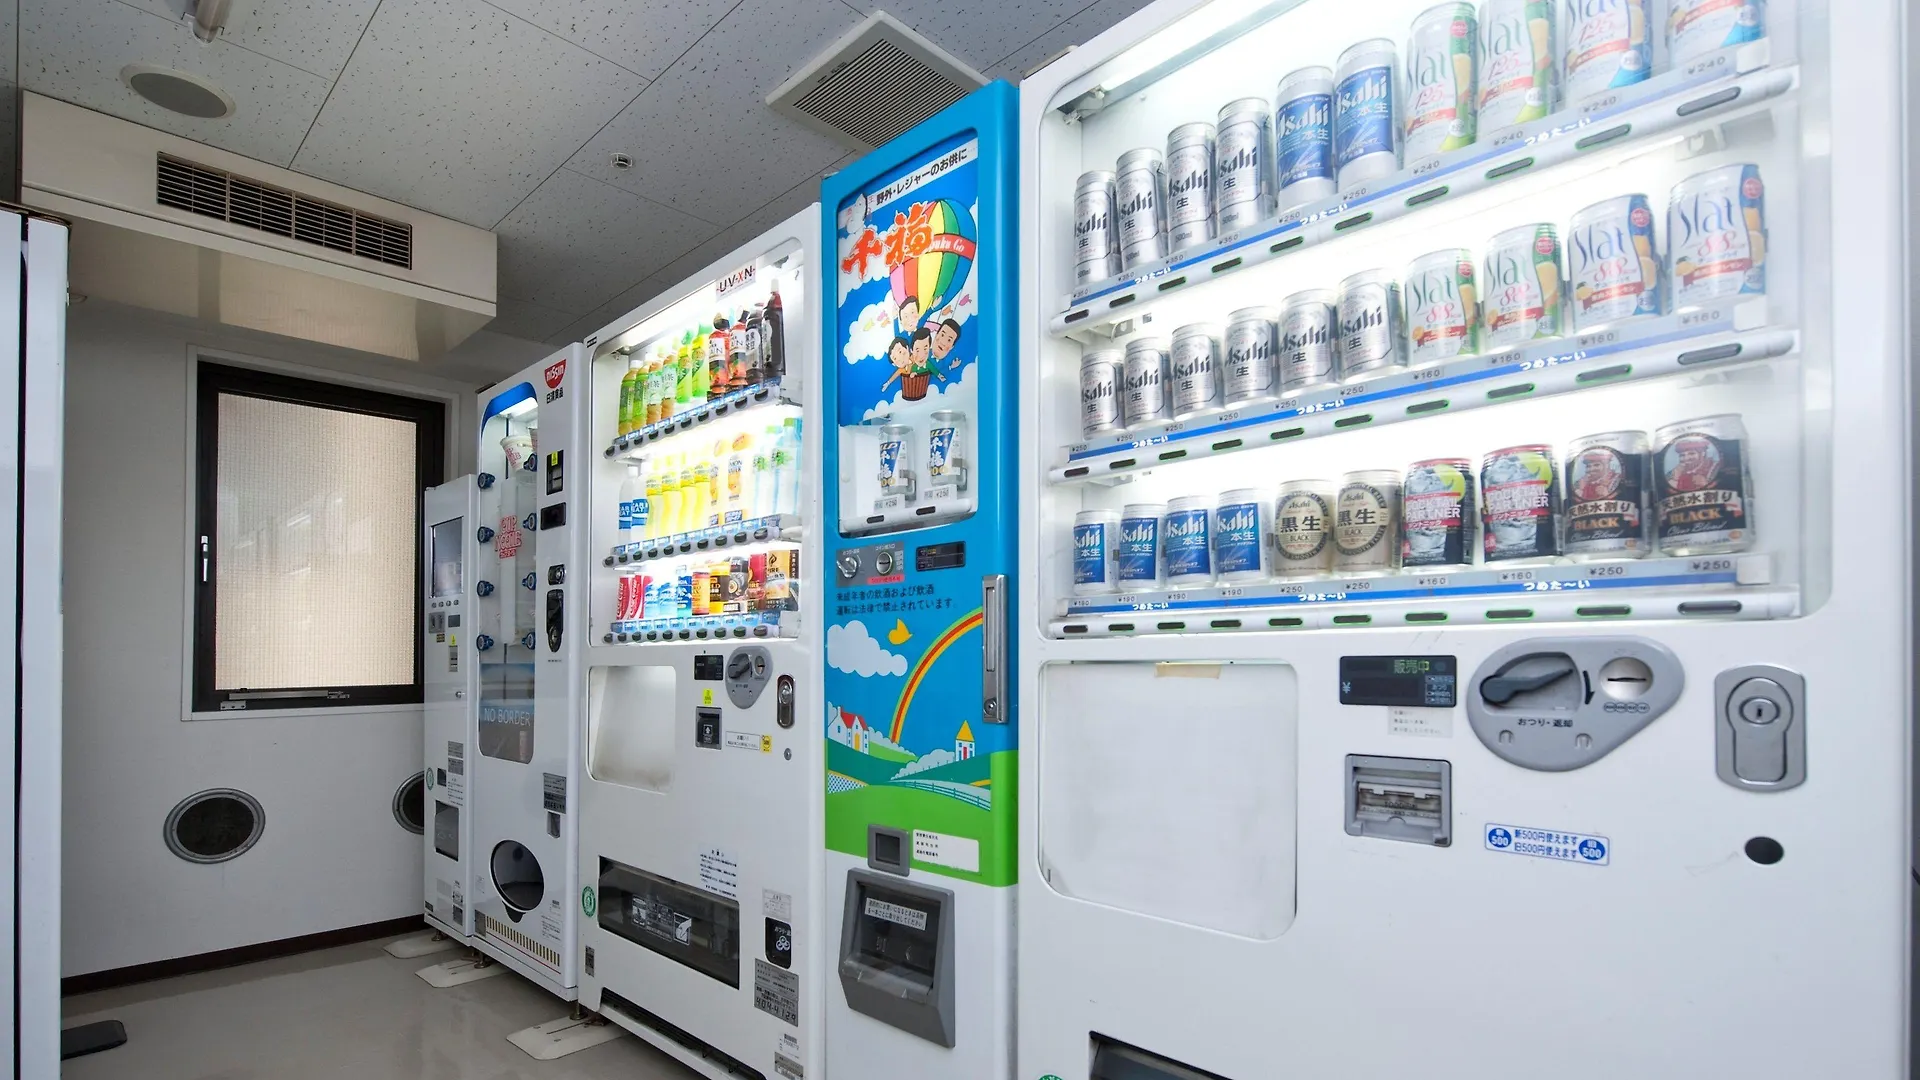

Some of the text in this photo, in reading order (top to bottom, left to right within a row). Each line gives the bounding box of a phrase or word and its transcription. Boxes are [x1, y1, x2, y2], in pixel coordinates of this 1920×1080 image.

[1218, 146, 1257, 178] sahi
[876, 148, 967, 205] 野外・レジャーのお供に
[1223, 177, 1236, 191] 生
[1120, 191, 1153, 220] sahi
[1176, 197, 1189, 210] 生
[1074, 212, 1107, 237] sahi
[1124, 219, 1136, 232] 生
[1079, 237, 1089, 248] 生
[1349, 337, 1362, 350] 生
[1292, 352, 1307, 364] 生
[1236, 366, 1250, 378] 生
[1181, 380, 1193, 391] 生
[1131, 392, 1142, 402] 生
[1087, 403, 1097, 413] 生
[1489, 496, 1549, 516] PARTNER
[1337, 508, 1377, 527] 黒生
[1406, 507, 1461, 522] PARTNER
[1669, 508, 1721, 525] BLACK
[1280, 515, 1322, 533] 黒生
[1574, 516, 1620, 531] BLACK
[1182, 536, 1206, 545] 本生
[1230, 531, 1256, 541] 本生
[1081, 549, 1101, 557] 本生
[1131, 544, 1153, 552] 本生
[1590, 566, 1624, 576] ¥250
[1692, 560, 1731, 570] ¥250
[1280, 585, 1303, 593] ¥250
[1346, 582, 1370, 590] ¥250
[1394, 659, 1430, 674] 販売中
[484, 707, 531, 727] NO BORDER
[1514, 829, 1578, 846] 新500円使えます
[1583, 848, 1602, 859] 500
